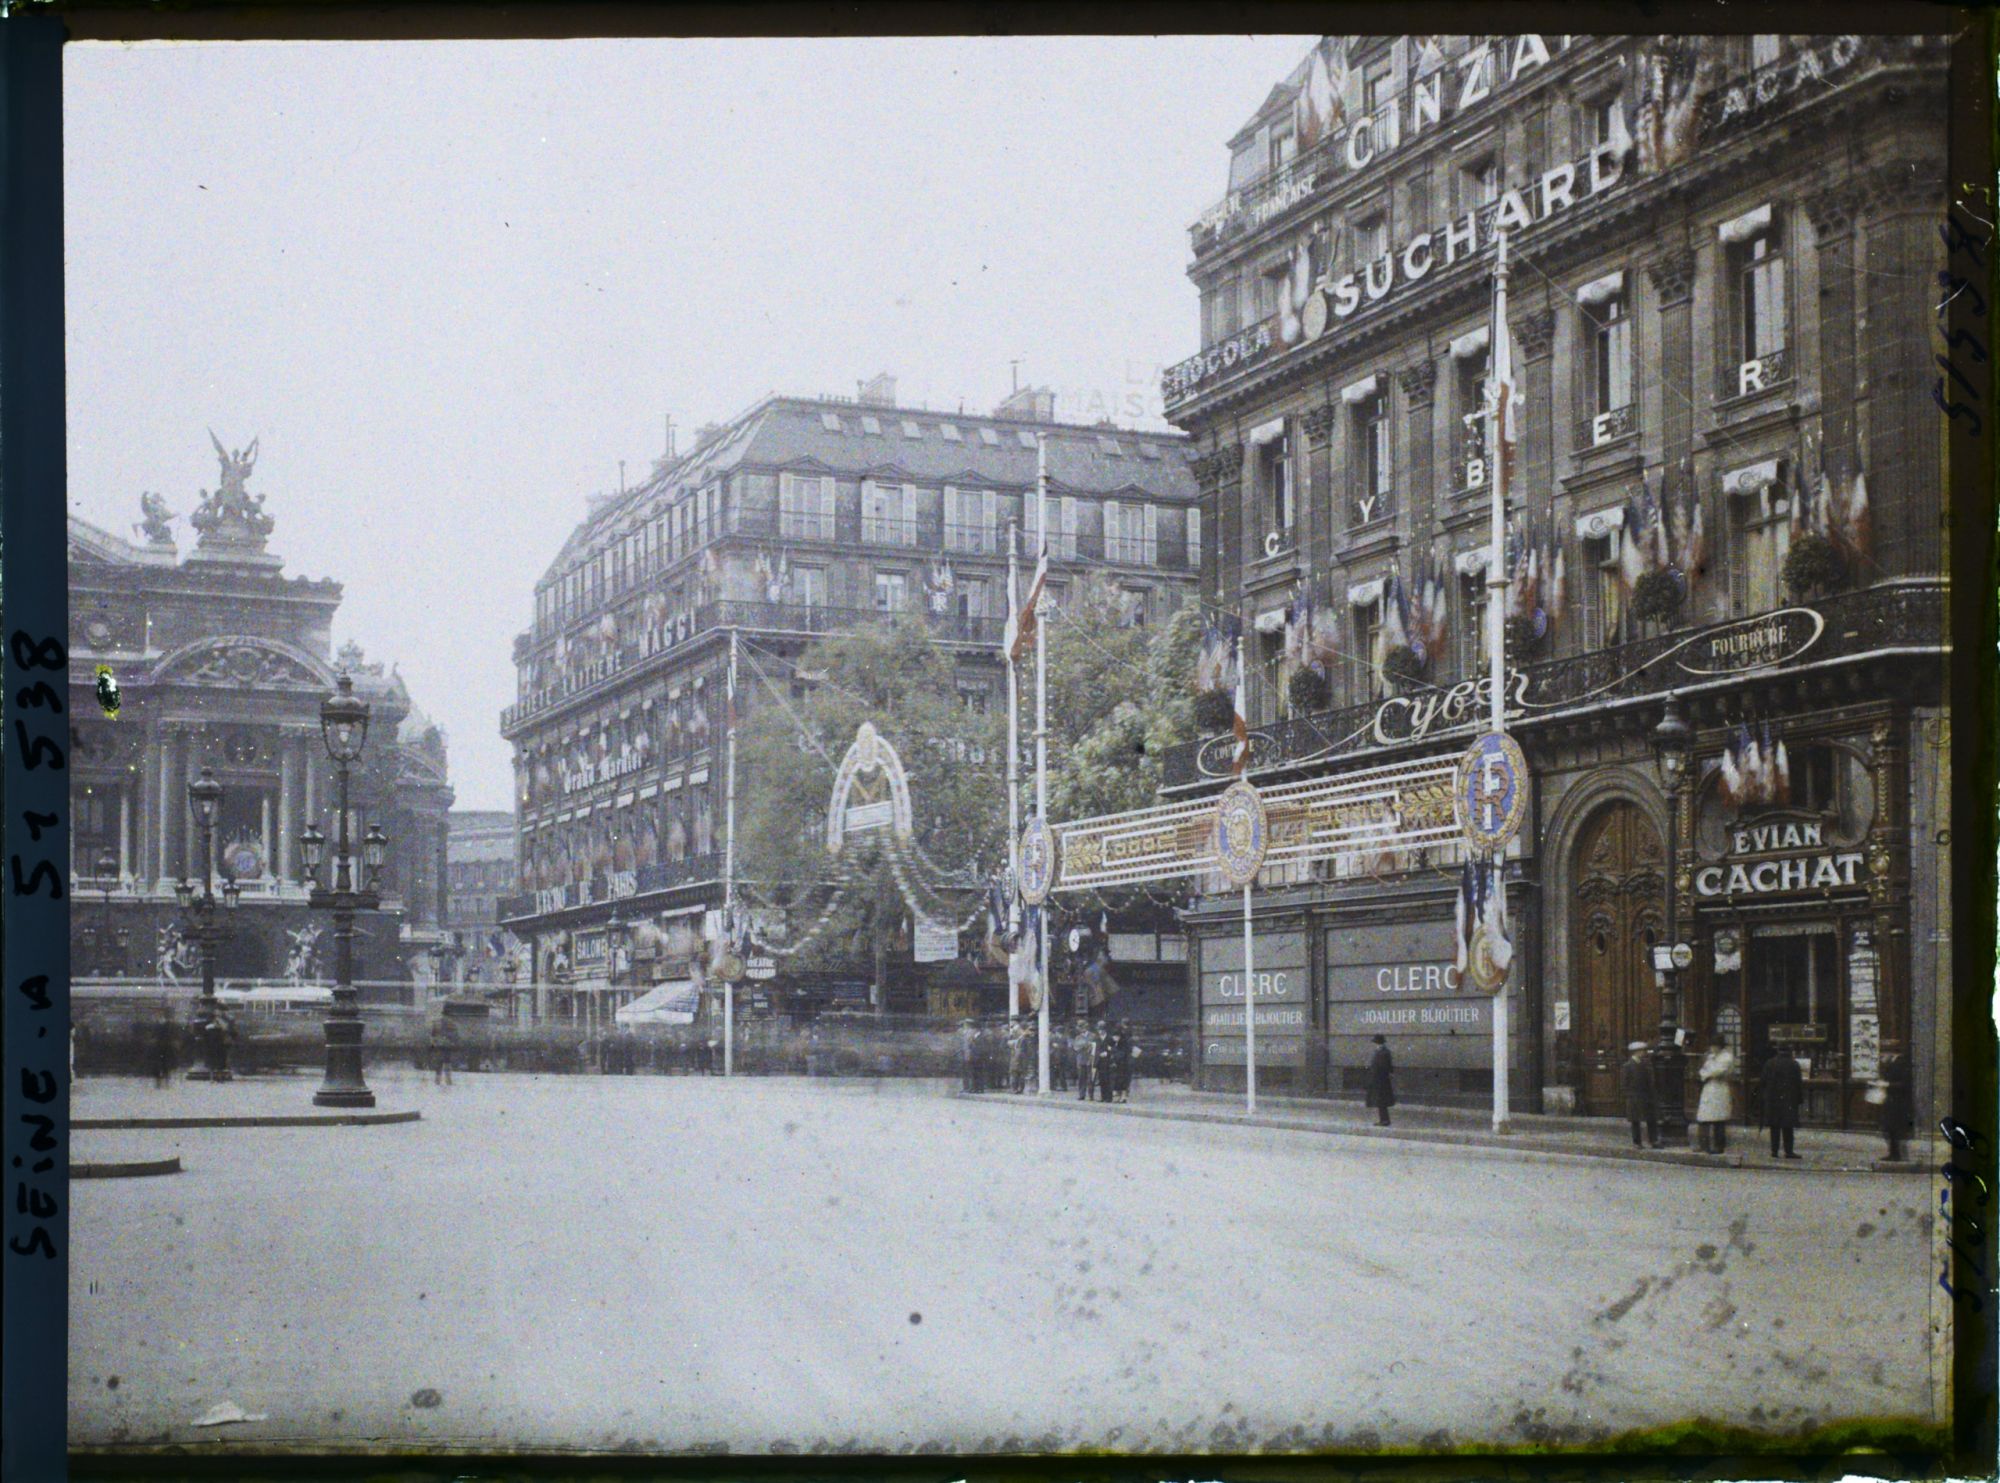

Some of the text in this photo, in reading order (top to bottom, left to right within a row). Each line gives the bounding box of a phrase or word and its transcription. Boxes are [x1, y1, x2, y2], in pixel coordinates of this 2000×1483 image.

[1347, 35, 1571, 169] CINZA
[1334, 143, 1624, 317] SUCHARD
[1160, 321, 1274, 398] CHOCOLA
[639, 607, 696, 659] MAGGI
[1214, 738, 1256, 761] COUTE
[1734, 822, 1823, 854] EVIAN
[1695, 853, 1865, 897] CACHAT
[1377, 964, 1460, 993] CLERC
[1207, 1010, 1304, 1027] JOAILLIE BIJOUTIER
[1361, 1006, 1480, 1026] JOAILLIER BIJOUTIER
